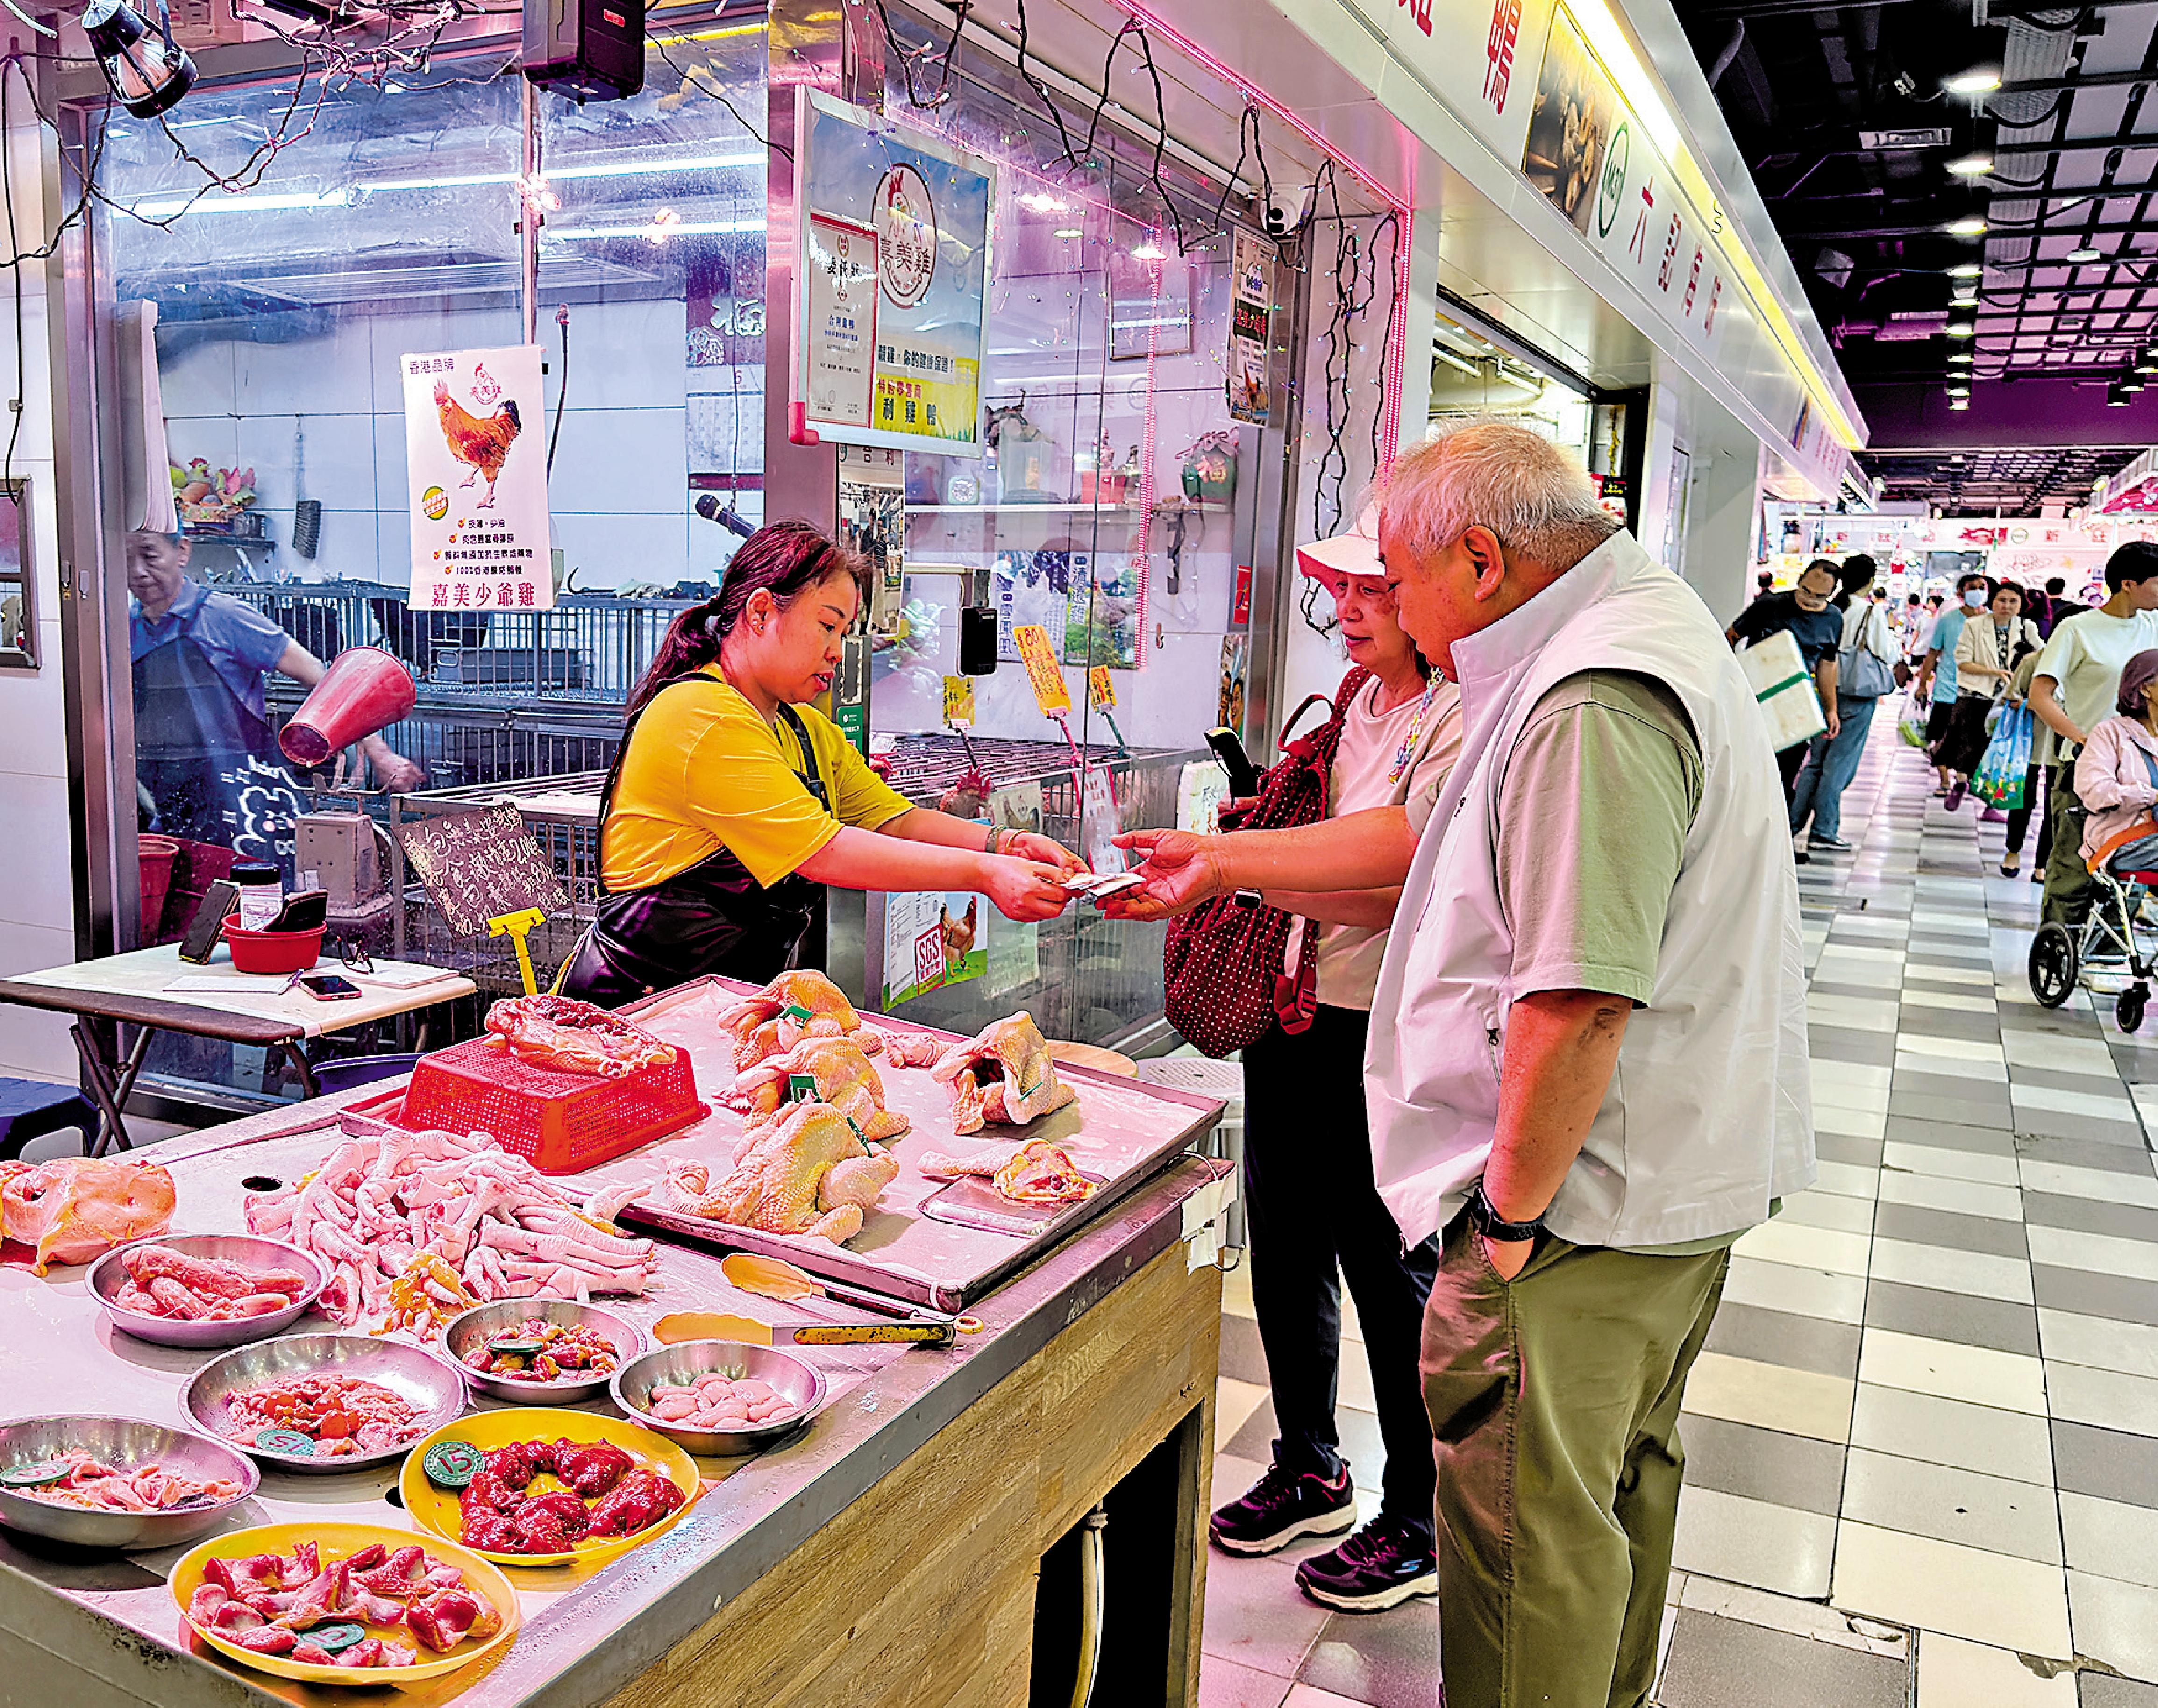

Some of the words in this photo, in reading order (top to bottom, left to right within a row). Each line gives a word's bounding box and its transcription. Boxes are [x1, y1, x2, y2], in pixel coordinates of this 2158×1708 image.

[410, 358, 454, 374] 香港品牌
[432, 582, 535, 606] 嘉美少爺雞
[919, 932, 940, 969] SGS
[438, 1448, 473, 1475] 15
